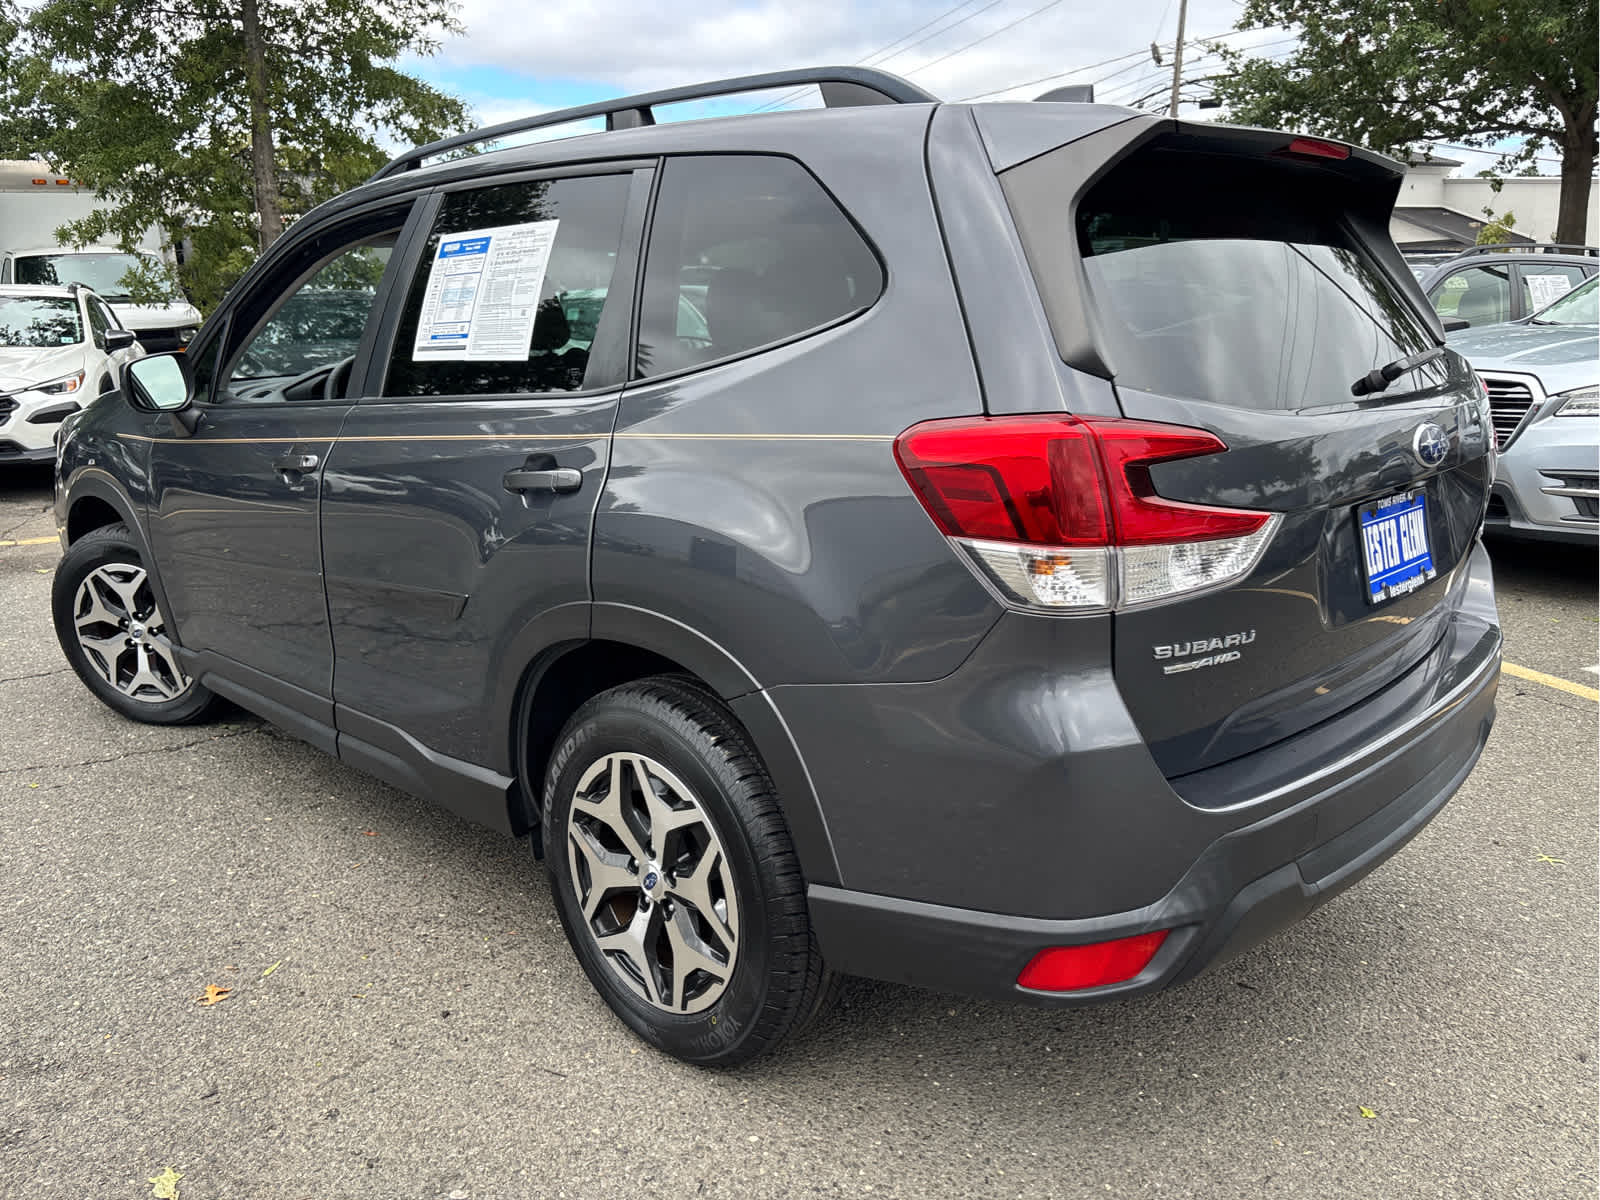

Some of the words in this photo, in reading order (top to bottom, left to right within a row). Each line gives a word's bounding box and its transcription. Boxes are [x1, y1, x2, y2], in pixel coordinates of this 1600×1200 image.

[1363, 519, 1400, 577] LESTER
[1400, 508, 1428, 562] GLENN
[1153, 629, 1256, 660] SUBARU
